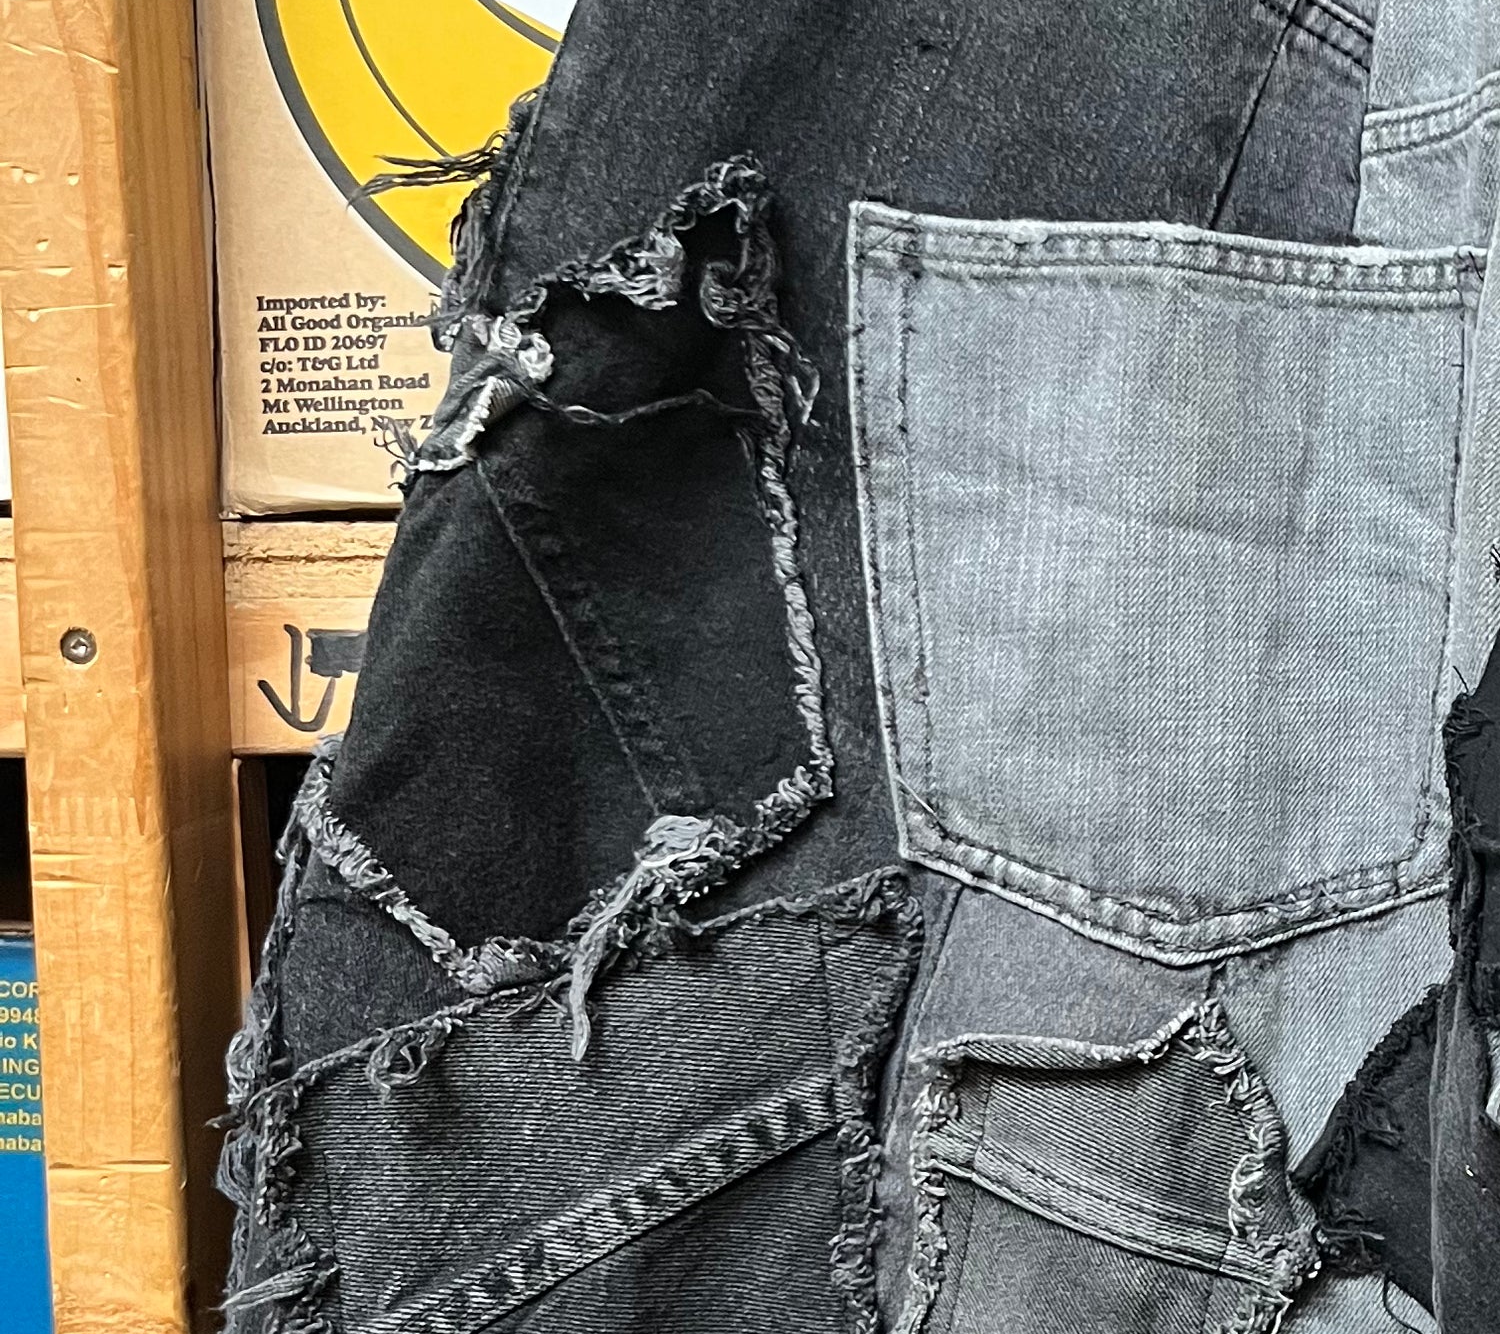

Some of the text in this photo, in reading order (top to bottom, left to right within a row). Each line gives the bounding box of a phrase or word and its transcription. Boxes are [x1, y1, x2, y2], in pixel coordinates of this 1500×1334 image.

[257, 293, 387, 315] Imported by:
[257, 314, 342, 333] All Good
[258, 333, 388, 354] FLO ID 20697
[260, 354, 380, 373] c/o: T&G Ltd
[261, 373, 430, 393] 2 Monahan Road
[262, 396, 404, 415] Mt Wellington
[262, 417, 367, 435] Auckland,
